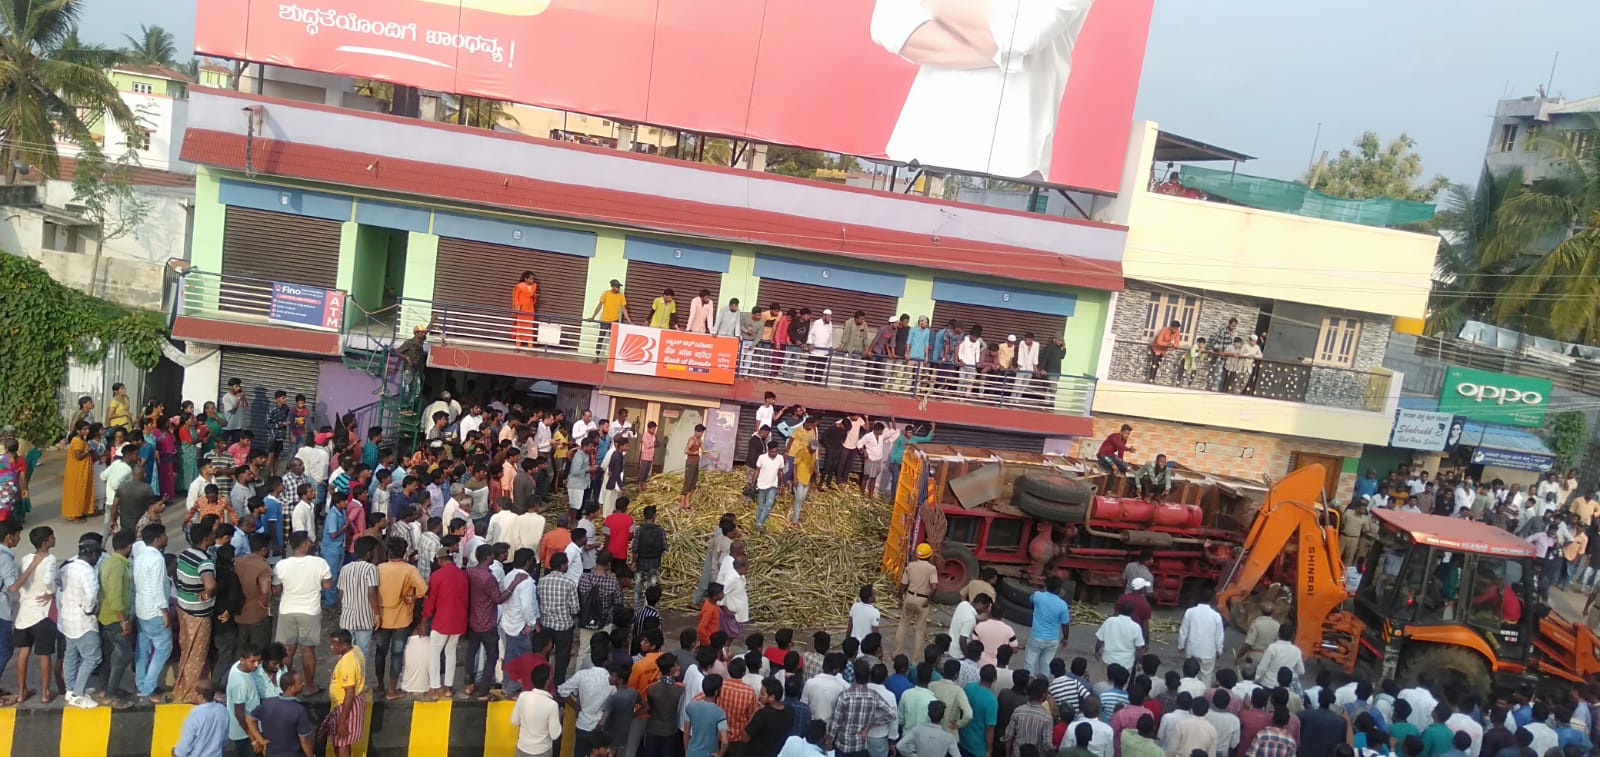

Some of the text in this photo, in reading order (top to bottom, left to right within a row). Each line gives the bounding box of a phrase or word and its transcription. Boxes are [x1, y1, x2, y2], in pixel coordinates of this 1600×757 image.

[282, 285, 302, 296] Fino
[326, 297, 340, 328] ATM
[681, 357, 688, 365] of
[688, 358, 712, 367] Baroda
[1306, 546, 1316, 597] SHINRAI
